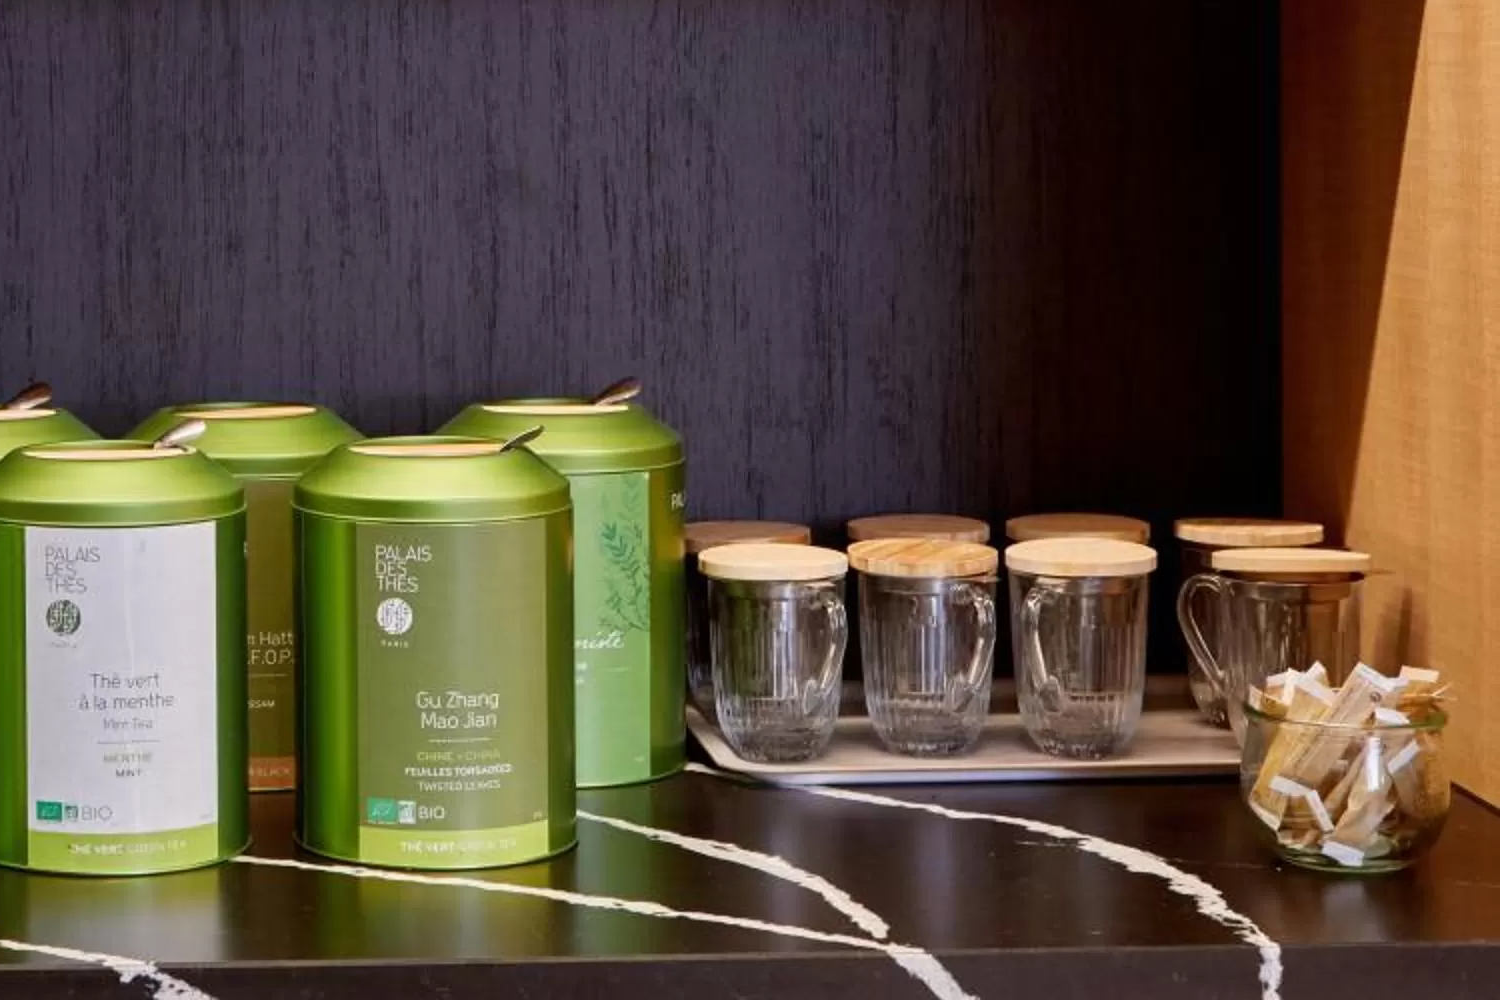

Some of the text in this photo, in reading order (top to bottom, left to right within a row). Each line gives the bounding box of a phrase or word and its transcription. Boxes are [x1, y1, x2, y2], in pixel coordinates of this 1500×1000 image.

[44, 545, 101, 563] PALAIS
[375, 545, 433, 562] PALAIS
[45, 561, 77, 577] DES
[375, 560, 408, 577] DES
[125, 673, 160, 689] vert
[94, 694, 108, 710] la
[113, 692, 175, 709] menthe
[416, 691, 500, 711] Gu Zhang
[421, 711, 497, 729] Mao Jian
[81, 806, 113, 821] BIO
[418, 805, 445, 820] BIO
